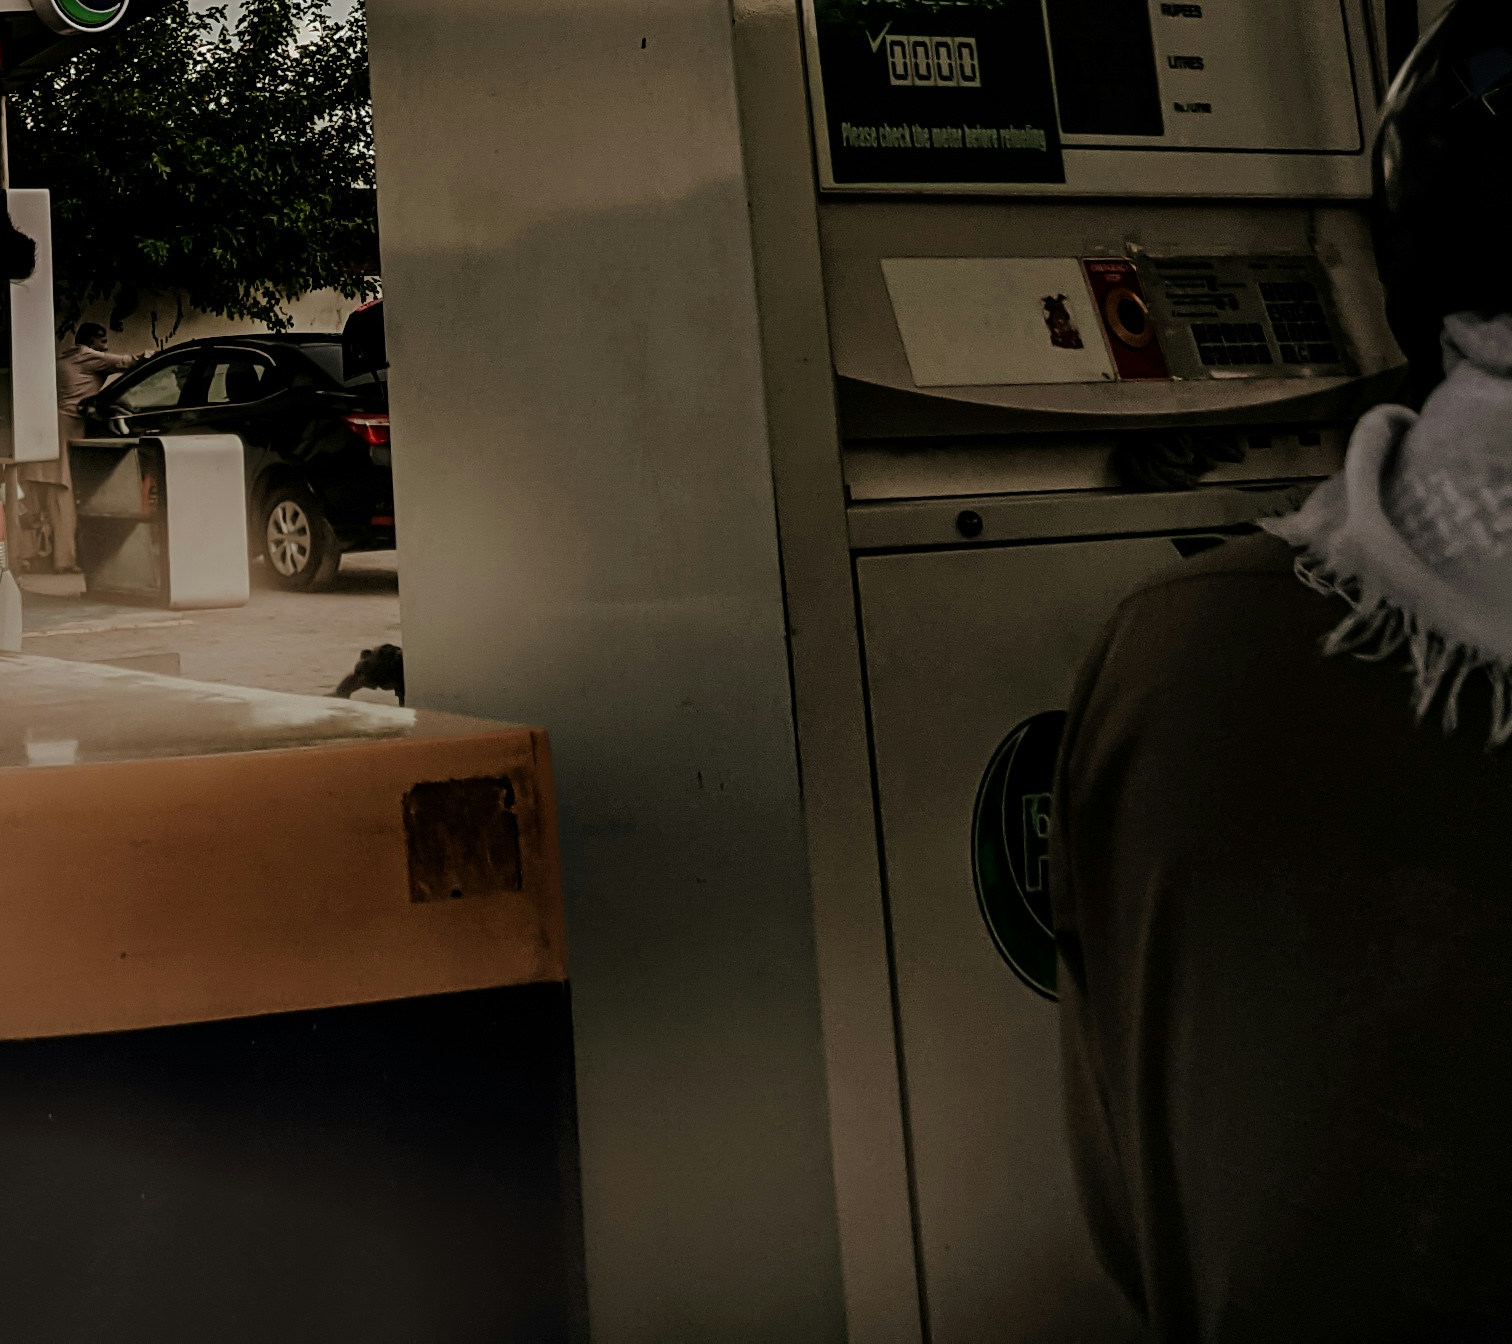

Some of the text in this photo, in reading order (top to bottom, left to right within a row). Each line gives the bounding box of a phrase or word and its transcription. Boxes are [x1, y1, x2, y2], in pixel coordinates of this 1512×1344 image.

[841, 121, 878, 148] Please
[879, 122, 912, 148] check
[912, 122, 931, 149] the
